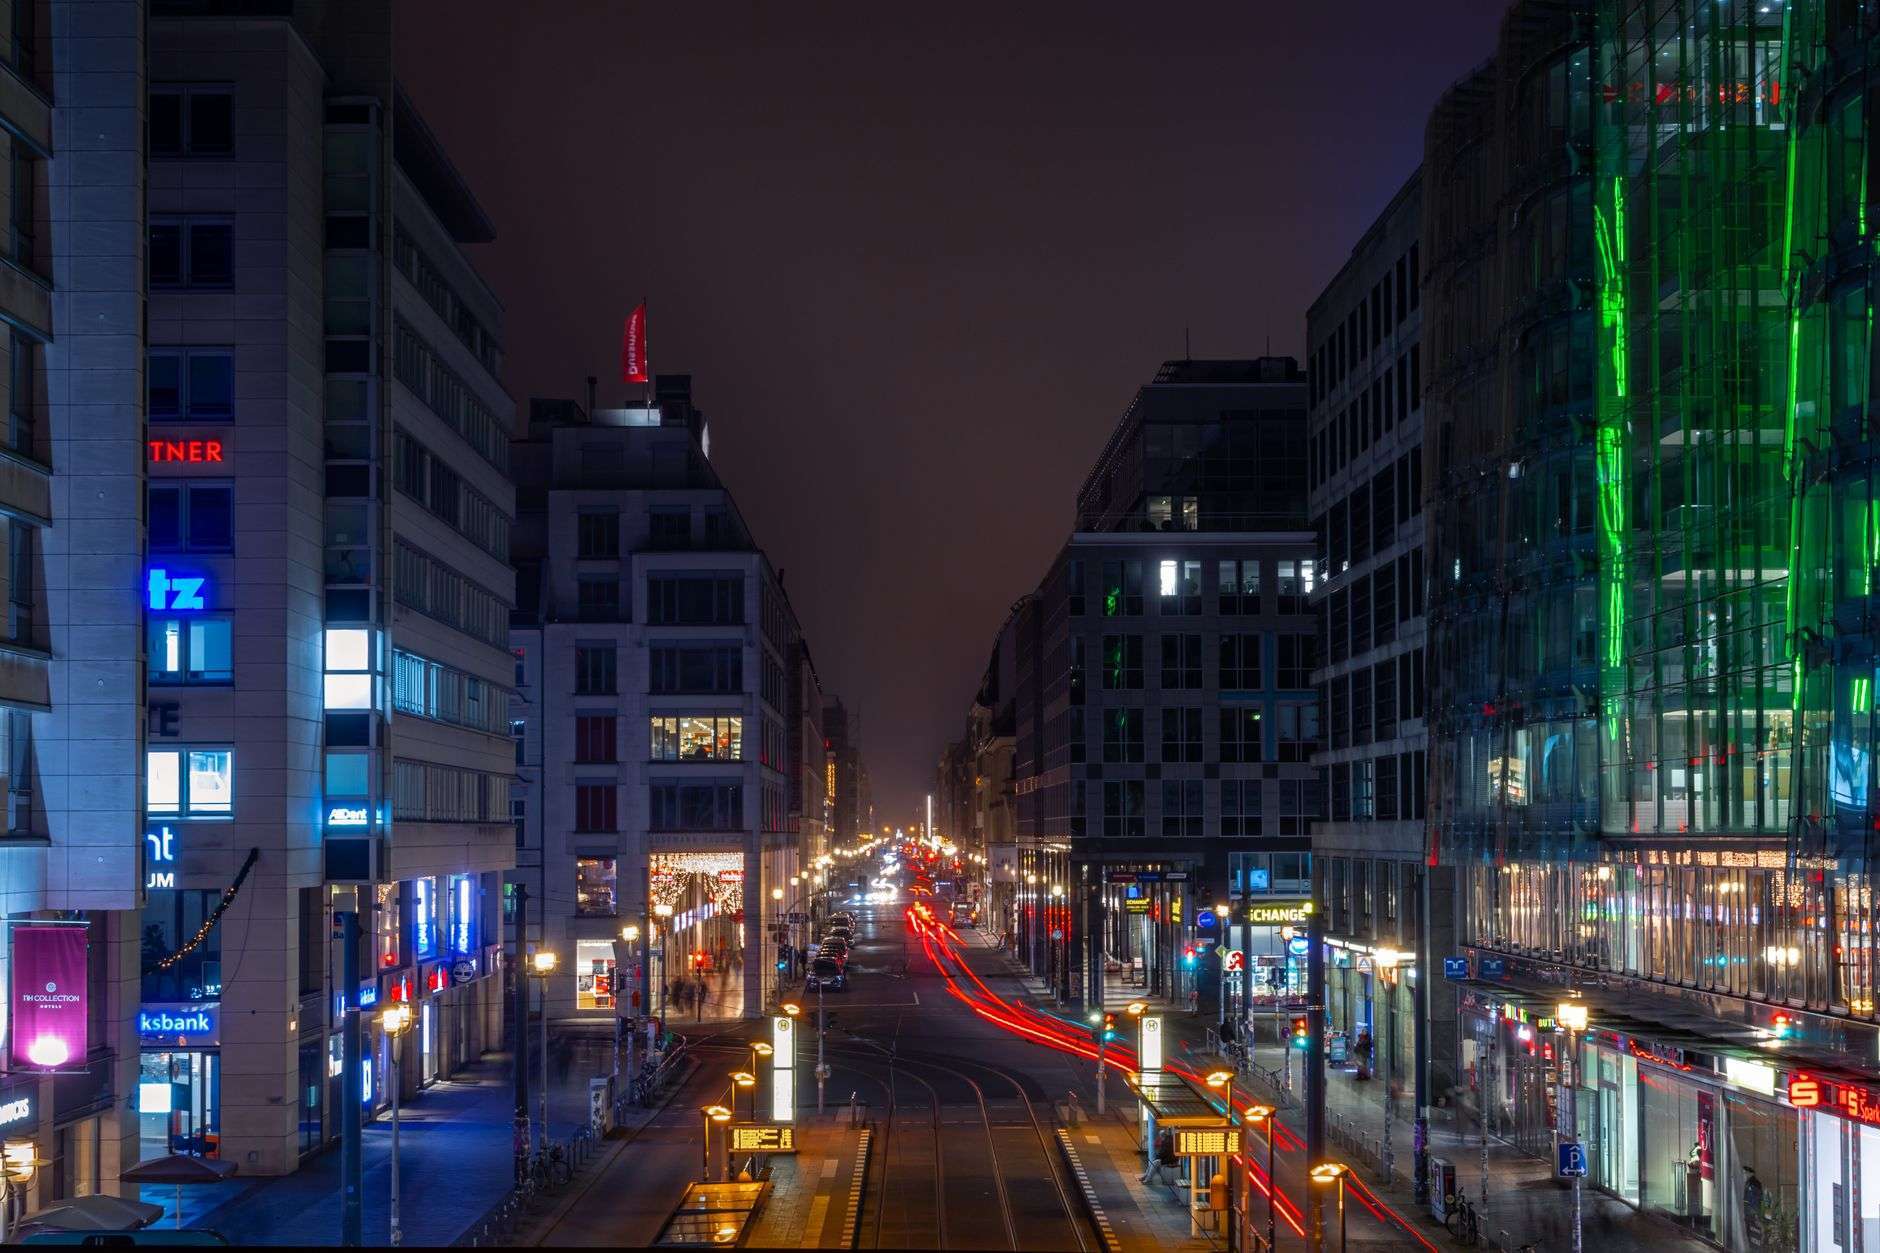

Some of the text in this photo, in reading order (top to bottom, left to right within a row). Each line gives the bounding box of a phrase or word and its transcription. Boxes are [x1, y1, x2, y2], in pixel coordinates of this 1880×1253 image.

[150, 441, 223, 462] TNER
[148, 569, 205, 609] tz
[1250, 908, 1306, 922] iCHANGE
[34, 994, 80, 1002] COLLECTION
[140, 1013, 209, 1031] ksbank
[1570, 1151, 1580, 1169] P
